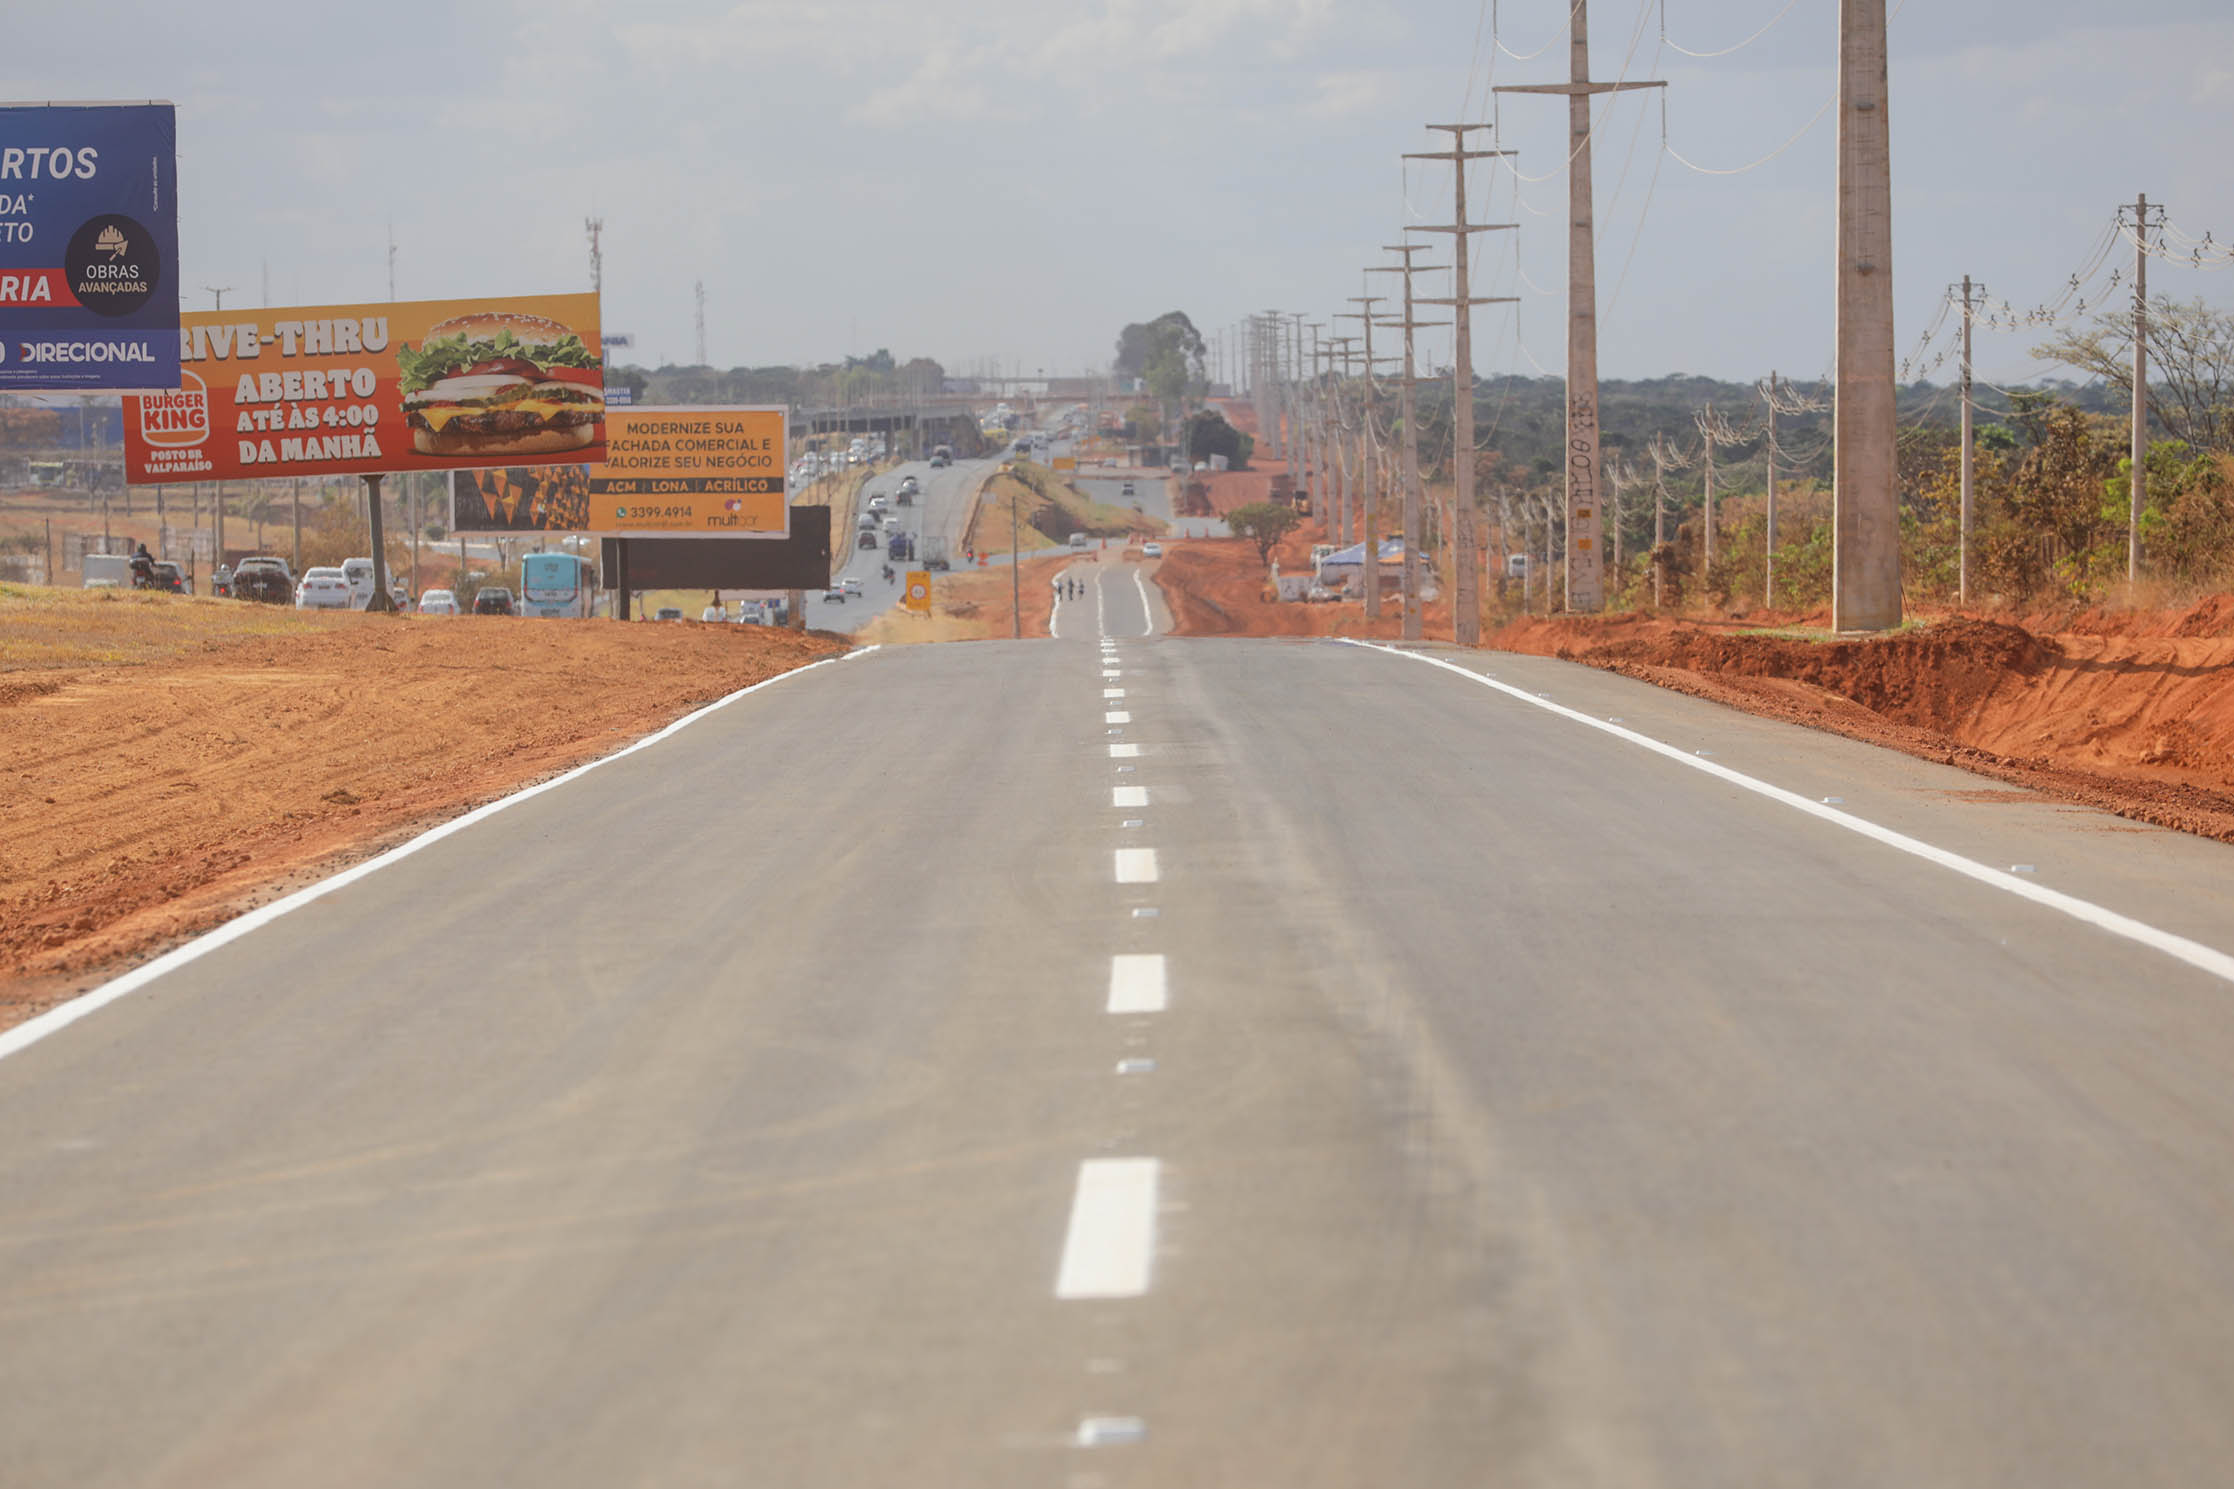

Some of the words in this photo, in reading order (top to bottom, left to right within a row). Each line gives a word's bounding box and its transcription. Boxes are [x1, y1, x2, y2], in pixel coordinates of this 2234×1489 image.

[1, 147, 98, 180] RTOS
[86, 264, 140, 279] OBRAS
[0, 275, 52, 302] RIA
[78, 281, 148, 295] AVANÇADAS
[19, 342, 156, 363] DIRECIONAL
[234, 367, 377, 405] ABERTO
[143, 393, 205, 410] BURGER
[143, 408, 206, 431] KING
[236, 402, 285, 433] ATÉ
[287, 402, 321, 430] ÀS
[322, 404, 380, 429] 4:00
[626, 422, 712, 435] MODERNIZE
[715, 422, 745, 434] SUA
[238, 439, 279, 465] DA
[280, 427, 383, 463] MANHÃ
[674, 438, 759, 451] COMERCIAL
[762, 438, 771, 450] E
[151, 449, 187, 462] POSTO
[187, 448, 203, 460] BR
[674, 455, 702, 468] SEU
[706, 452, 773, 468] NEGÓCIO
[143, 459, 213, 474] VALPARAÍSO
[606, 480, 637, 493] ACM
[651, 480, 689, 492] LONA
[704, 477, 769, 492] ACRÍLICO
[630, 506, 693, 519] 3399.4914
